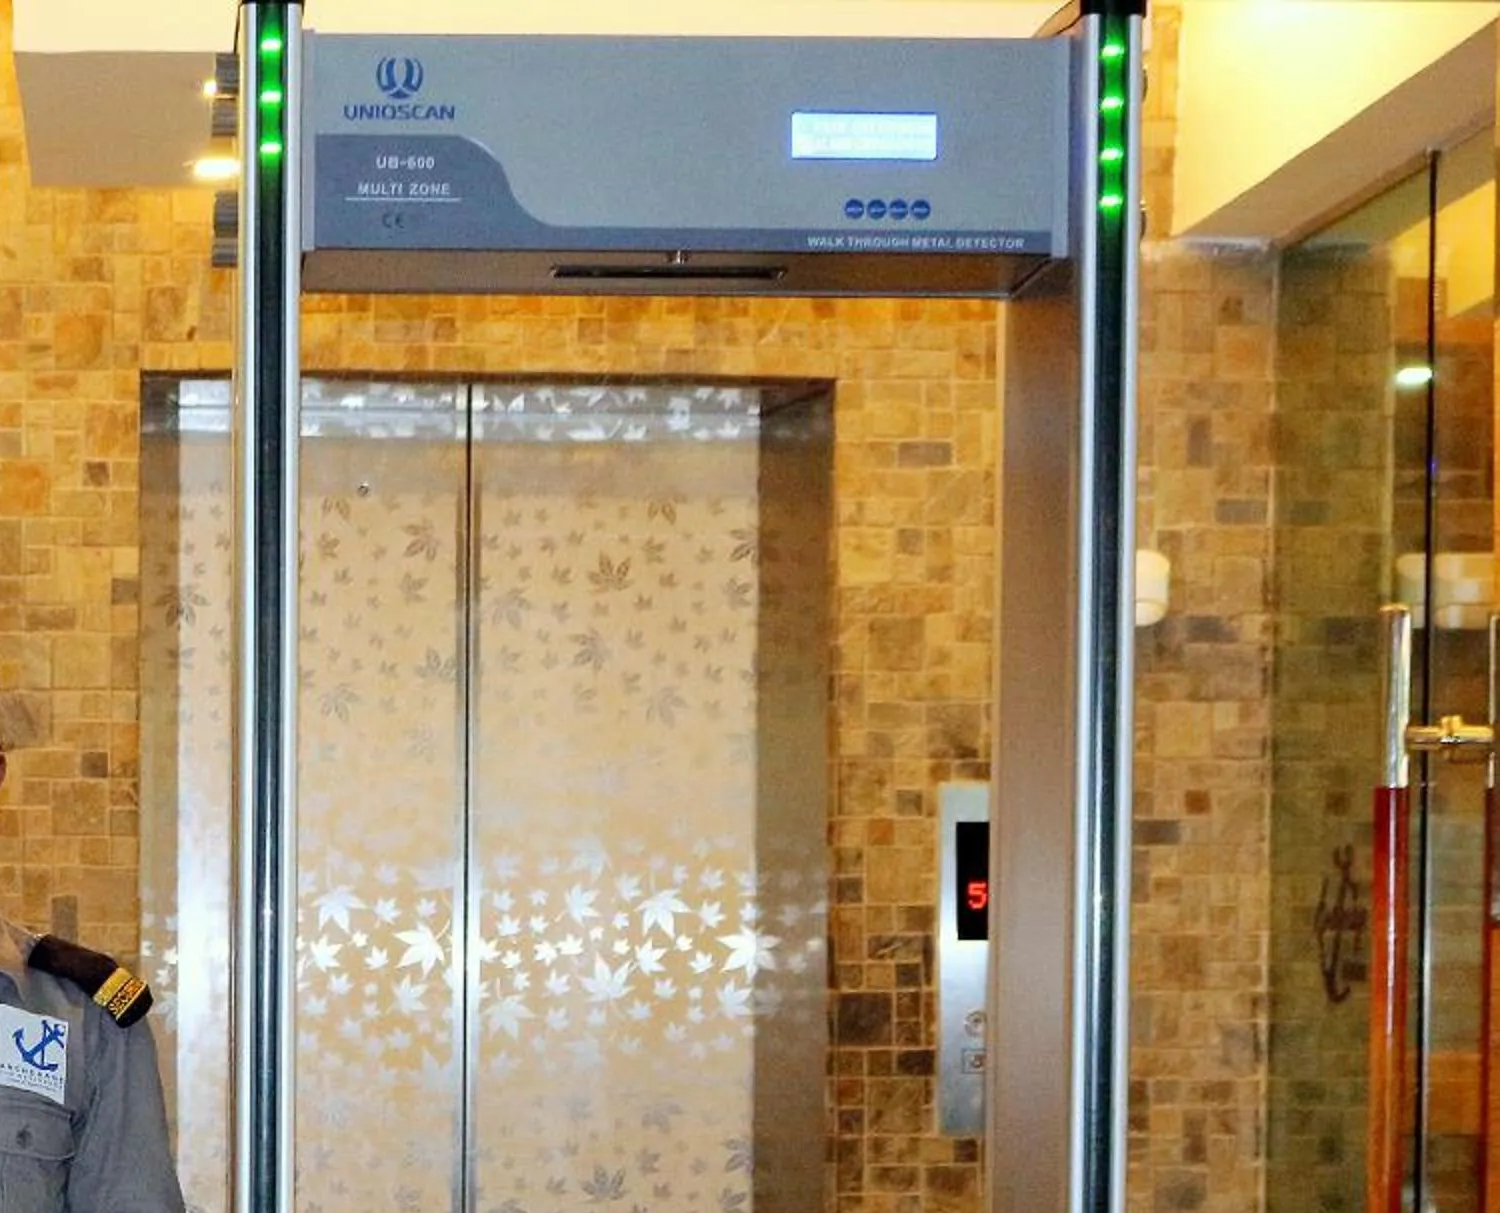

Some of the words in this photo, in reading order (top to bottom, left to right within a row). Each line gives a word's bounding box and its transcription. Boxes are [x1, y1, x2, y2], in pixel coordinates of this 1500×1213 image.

[357, 181, 402, 196] MULTI
[409, 182, 450, 196] ZONE
[807, 235, 845, 247] WALK
[847, 236, 910, 249] THROUGH
[911, 237, 953, 249] METAL
[958, 238, 1025, 249] DETECTOR
[967, 882, 987, 909] 5
